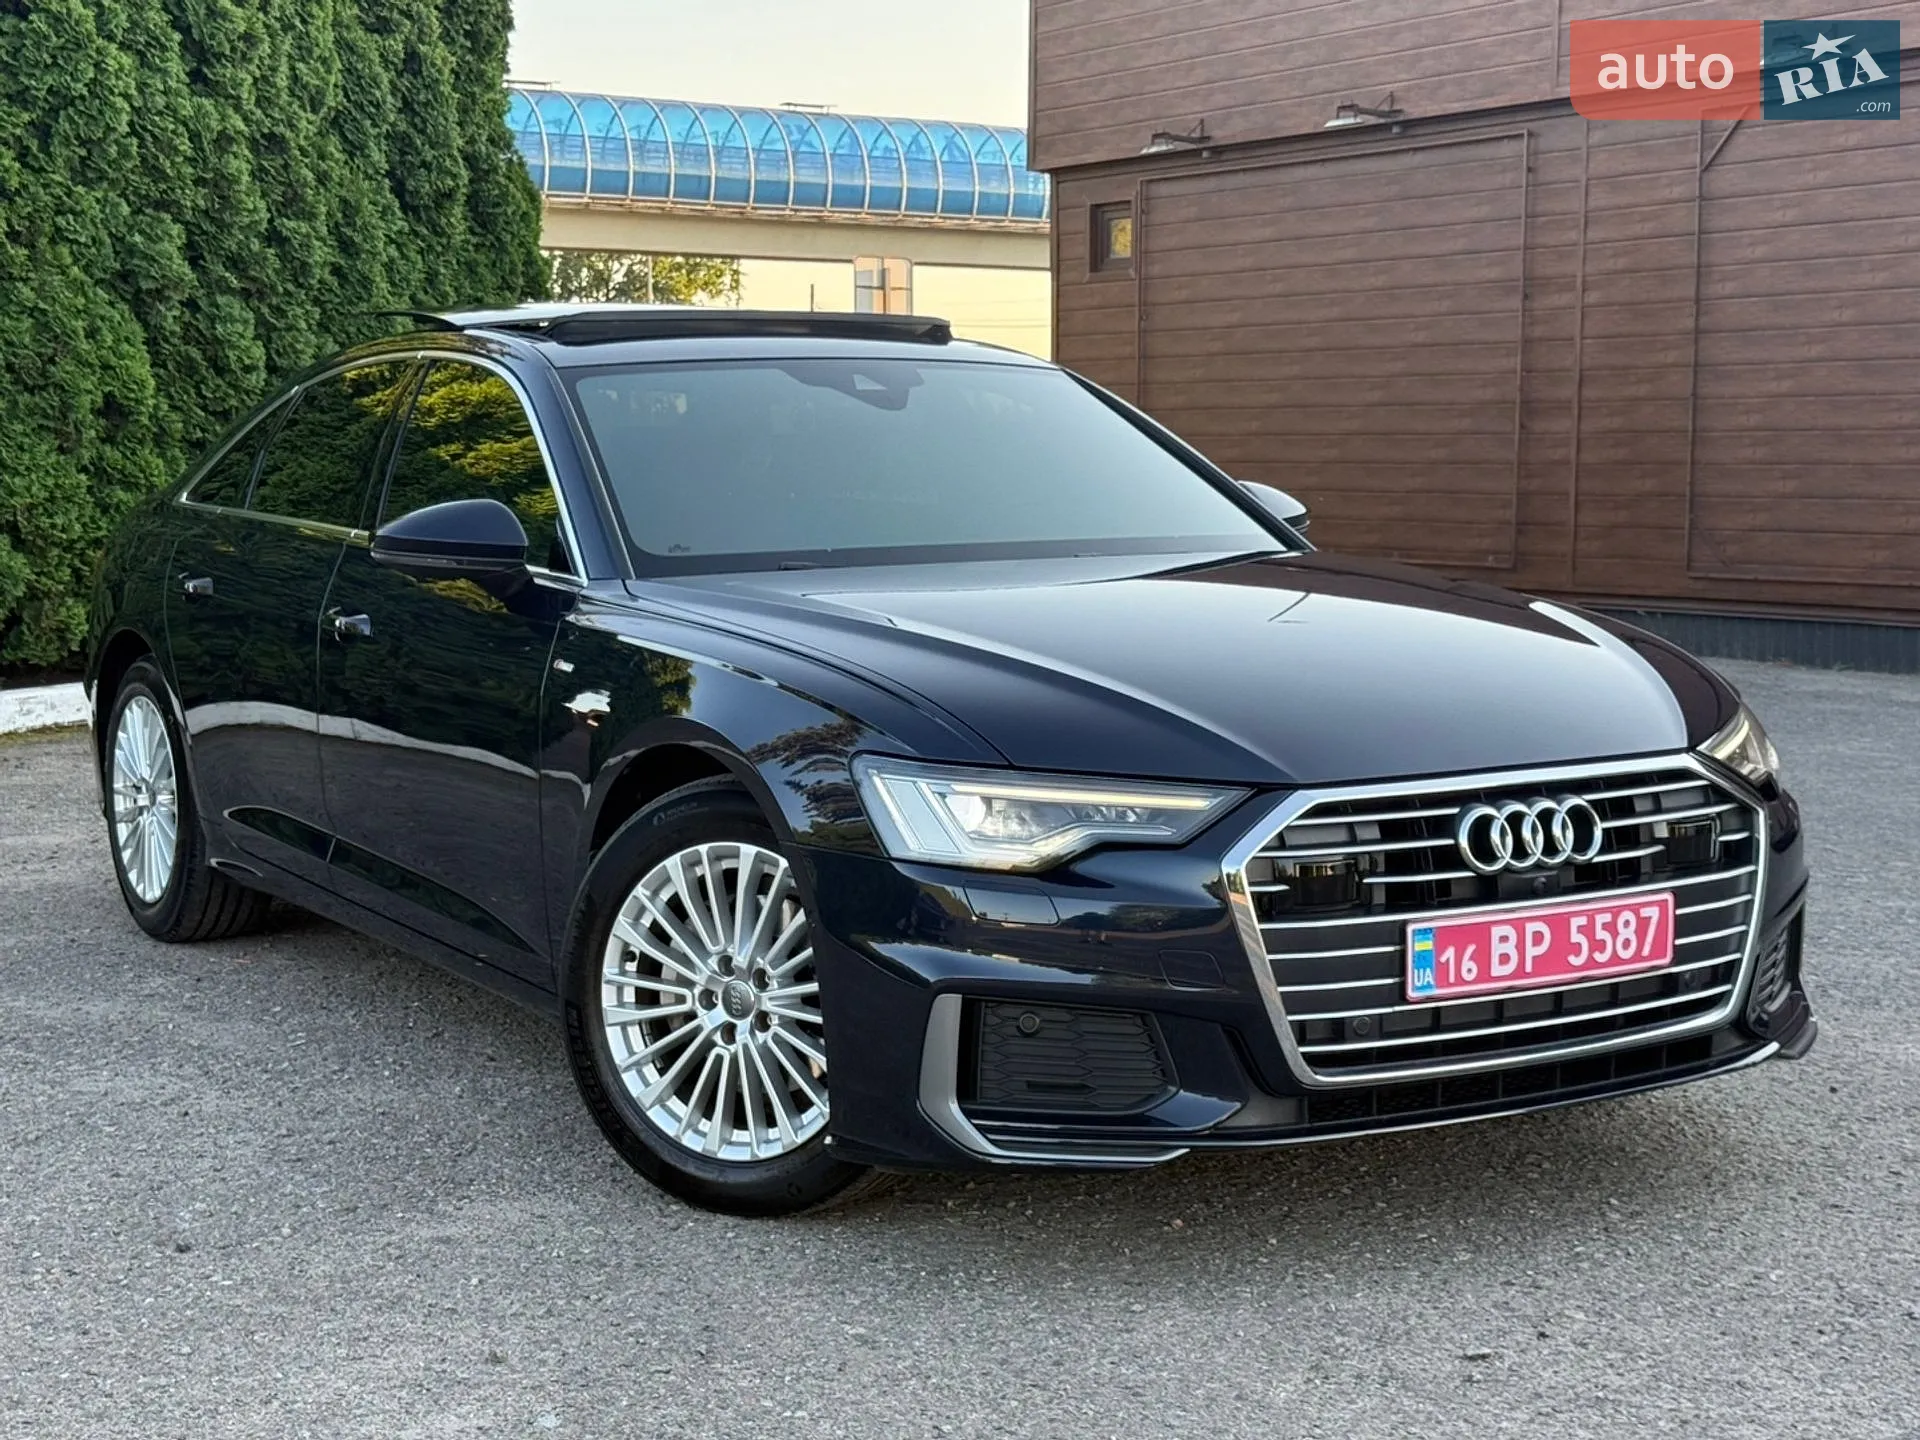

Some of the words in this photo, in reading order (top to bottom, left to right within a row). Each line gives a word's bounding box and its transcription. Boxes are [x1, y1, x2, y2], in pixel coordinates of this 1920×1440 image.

[1439, 944, 1478, 984] 16
[1490, 921, 1552, 978] BP
[1567, 906, 1660, 967] 5587
[1414, 967, 1435, 987] UA
